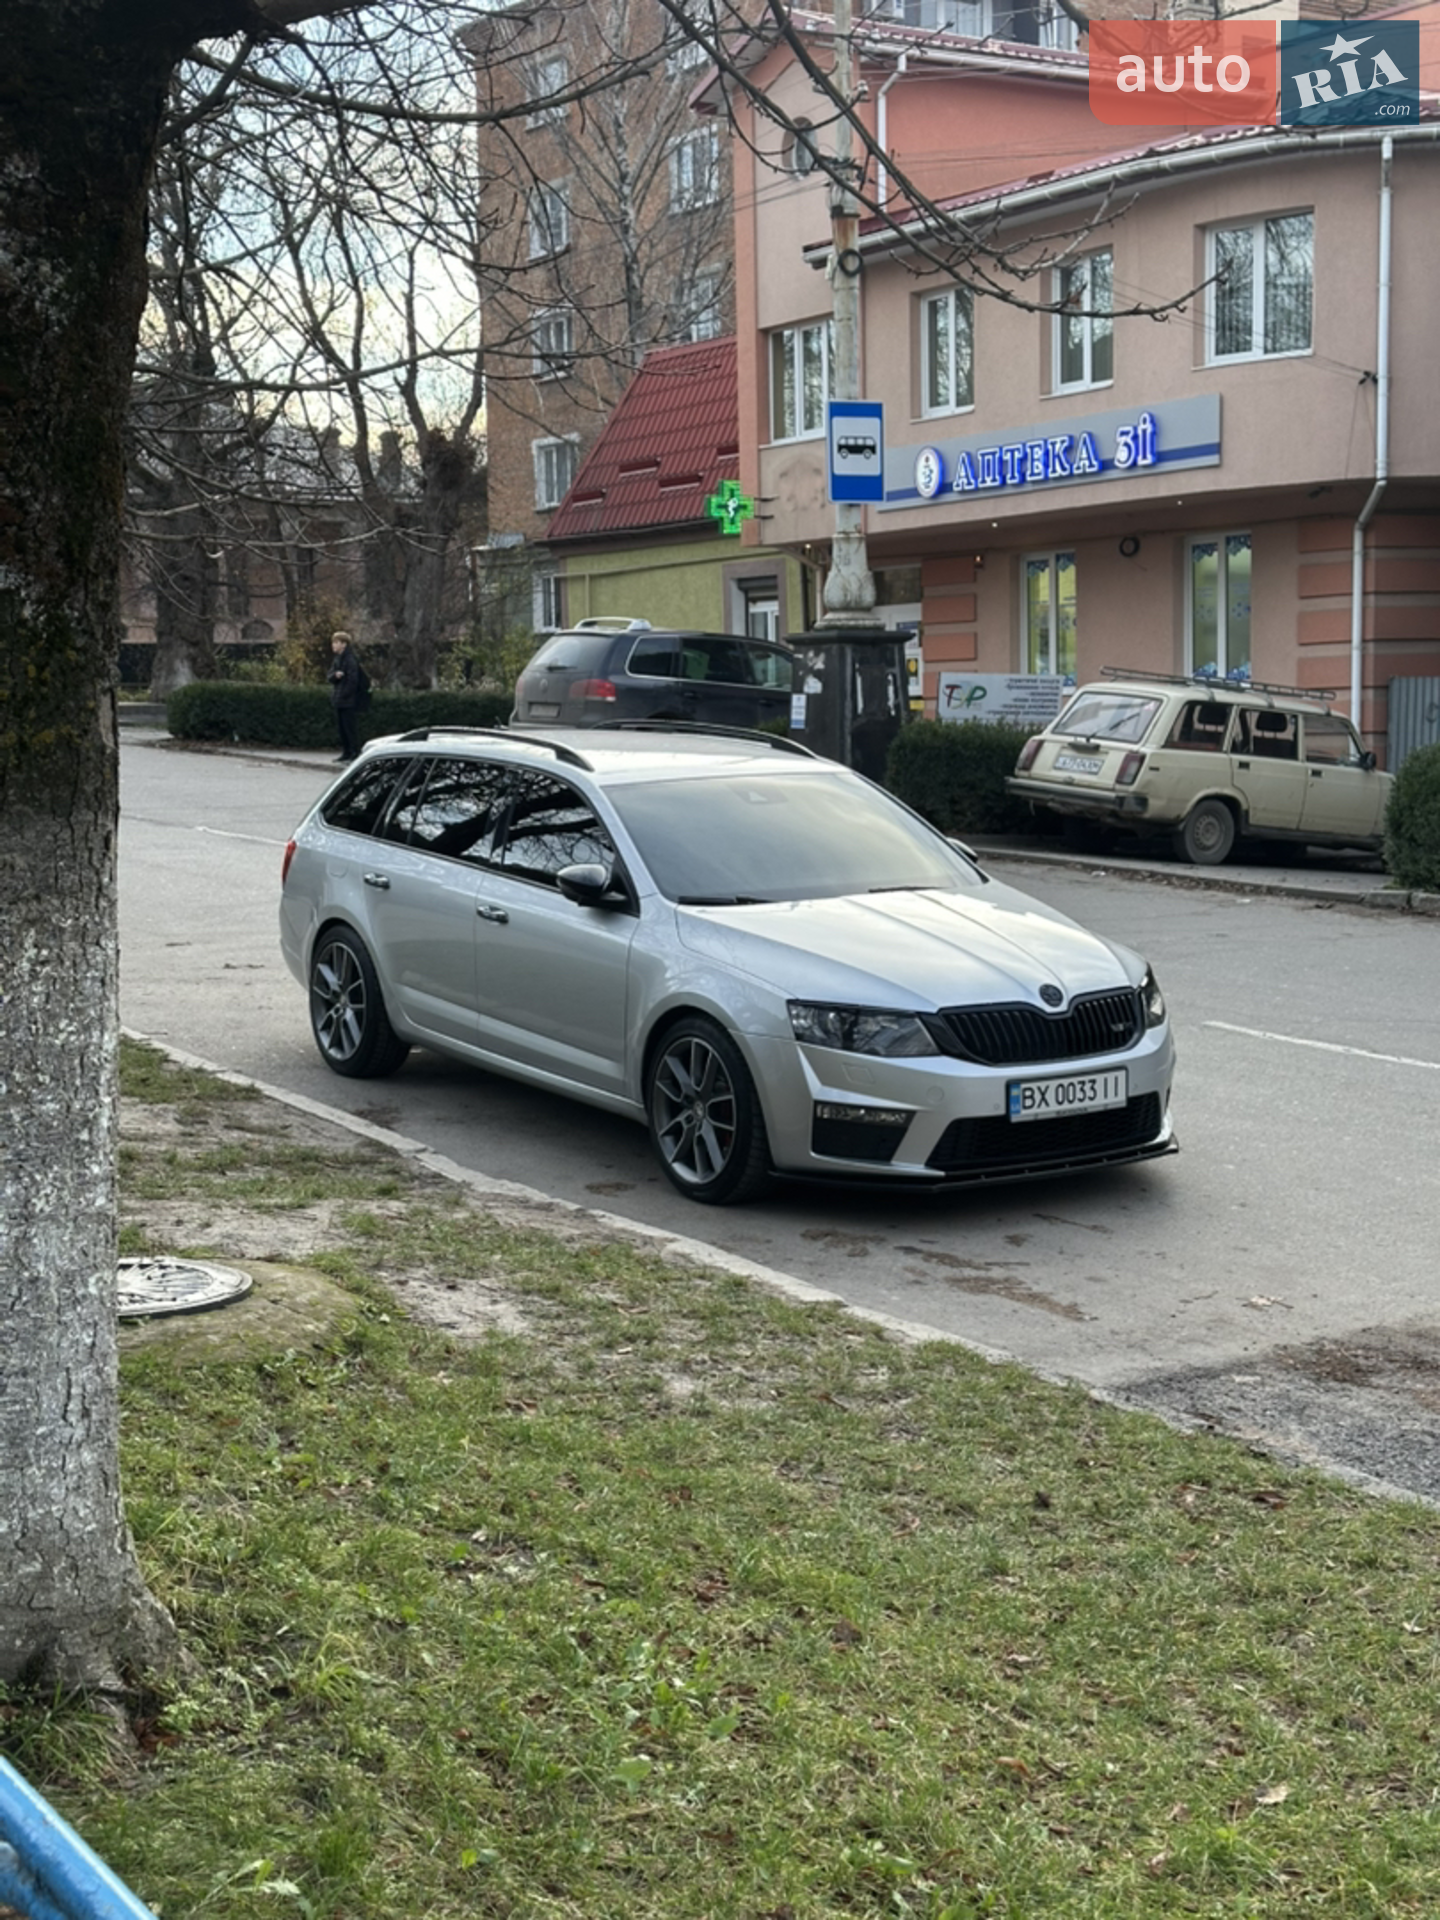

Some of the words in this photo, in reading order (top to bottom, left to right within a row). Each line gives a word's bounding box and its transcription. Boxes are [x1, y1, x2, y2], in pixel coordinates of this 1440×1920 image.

[953, 432, 1100, 491] АПТЕКА
[1022, 1085, 1050, 1110] BX
[1055, 1079, 1097, 1105] 0033
